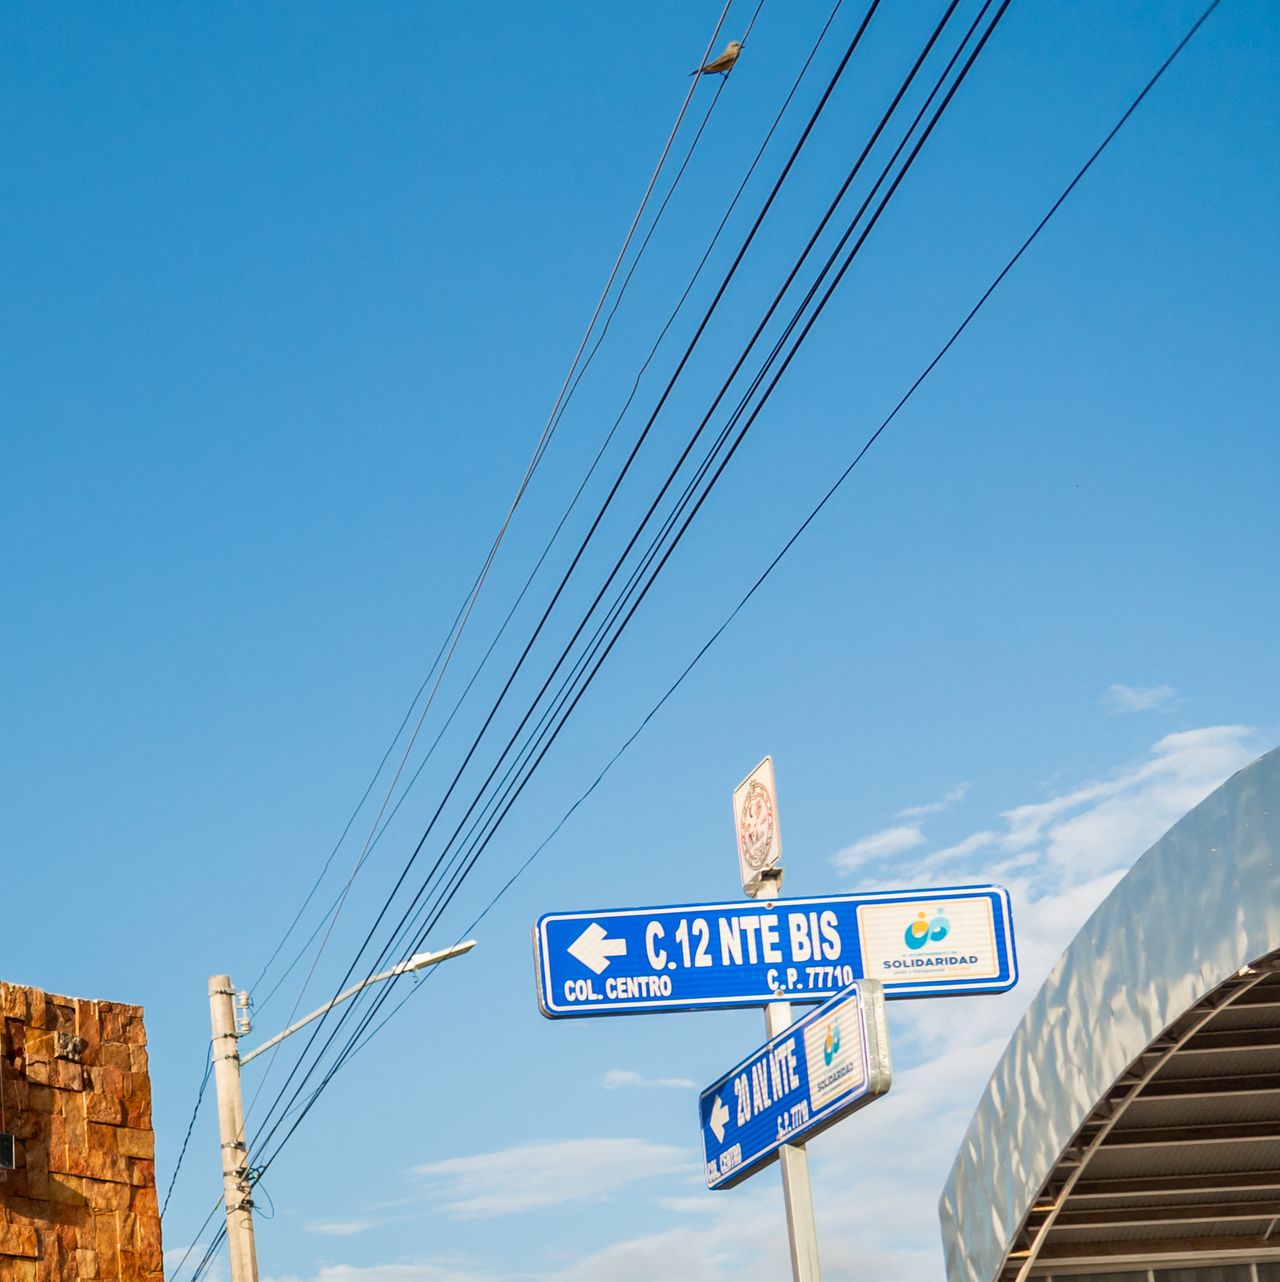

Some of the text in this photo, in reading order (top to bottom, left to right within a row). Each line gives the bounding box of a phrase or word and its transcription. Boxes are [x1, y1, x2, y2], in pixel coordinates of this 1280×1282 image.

[718, 914, 783, 966] NTE
[788, 910, 842, 962] BIS
[883, 955, 979, 969] SOLIDARIDAD
[564, 975, 672, 1001] COL. CENTRO
[805, 965, 853, 988] 77710
[734, 1073, 751, 1127] 20
[769, 1037, 800, 1102] NTE
[817, 1062, 854, 1092] SOLIDARIDAD
